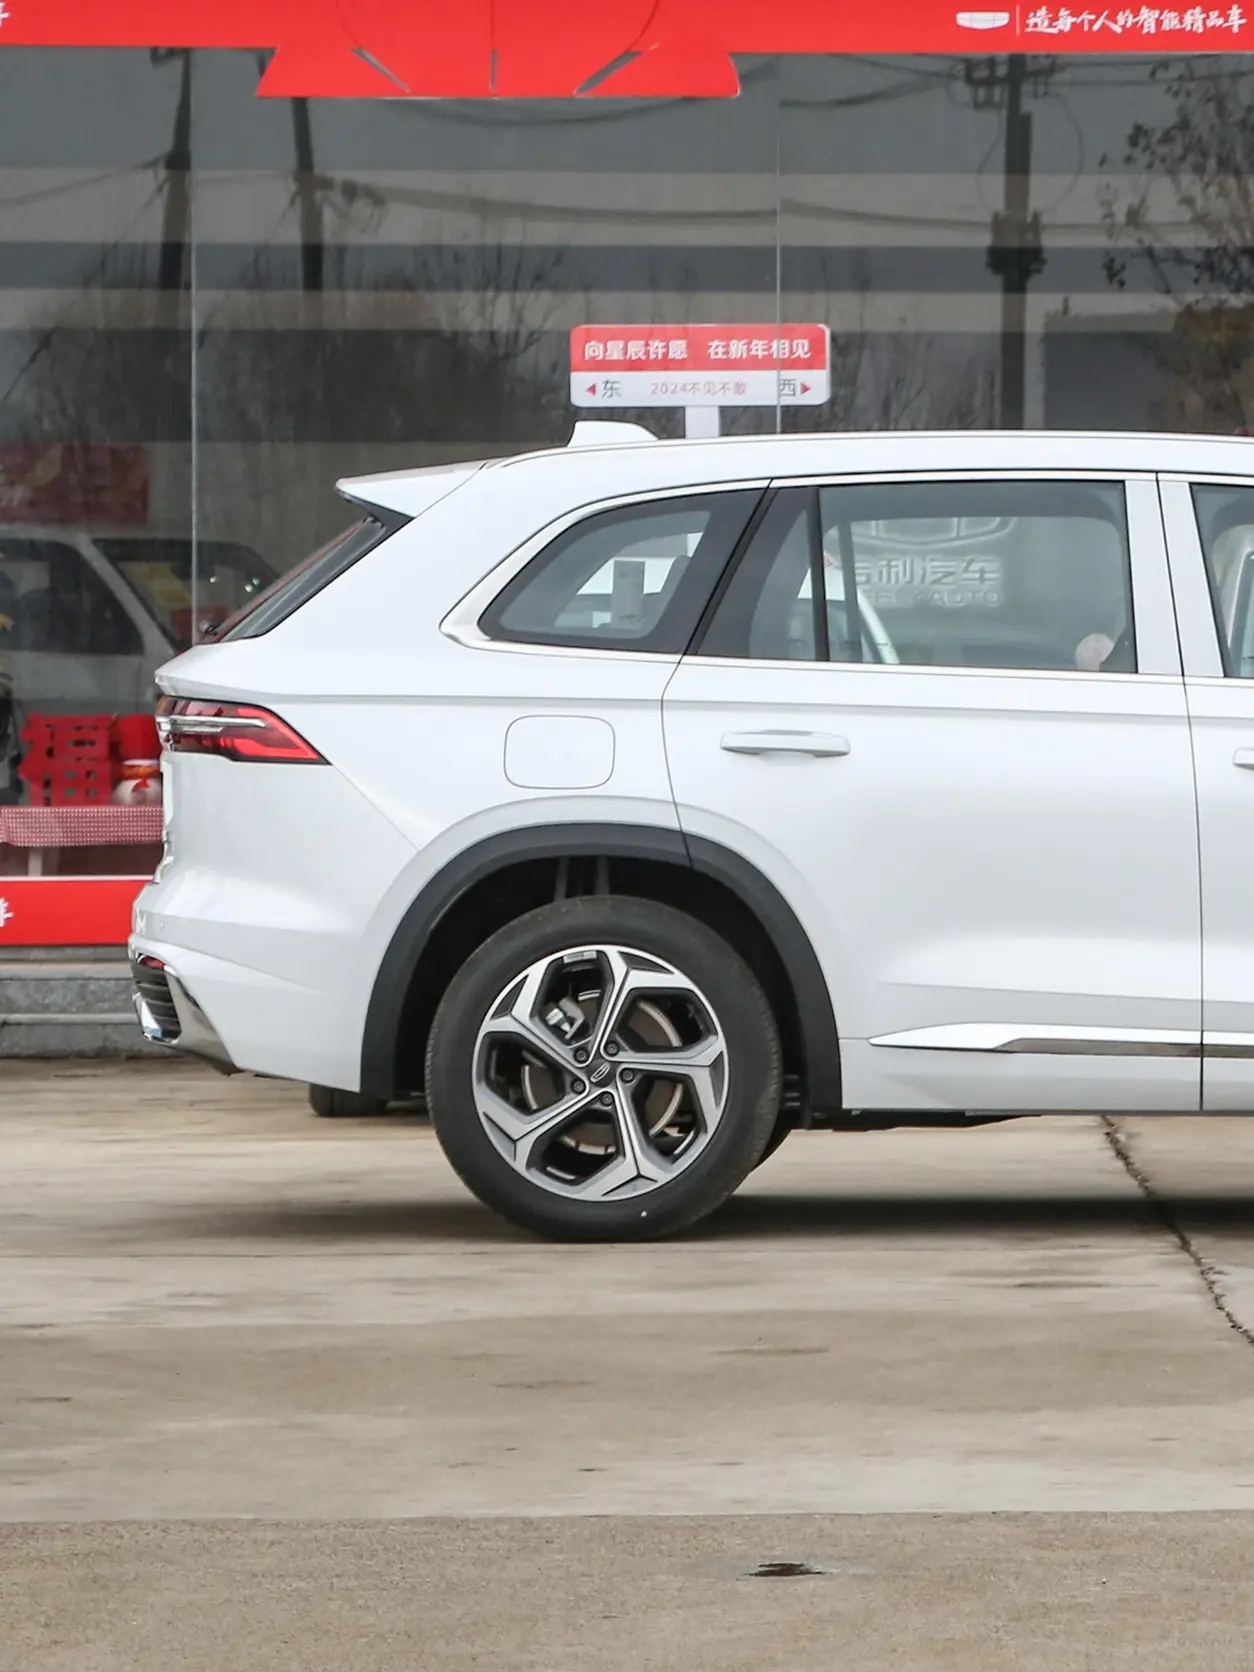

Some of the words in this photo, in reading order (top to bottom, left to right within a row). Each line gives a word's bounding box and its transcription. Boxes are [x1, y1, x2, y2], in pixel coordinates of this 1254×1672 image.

[1024, 4, 1248, 35] 造每个人的智能精品车
[584, 339, 689, 361] 向星辰许愿
[707, 338, 812, 360] 在新年相见
[601, 379, 622, 399] 东
[778, 377, 797, 398] 西
